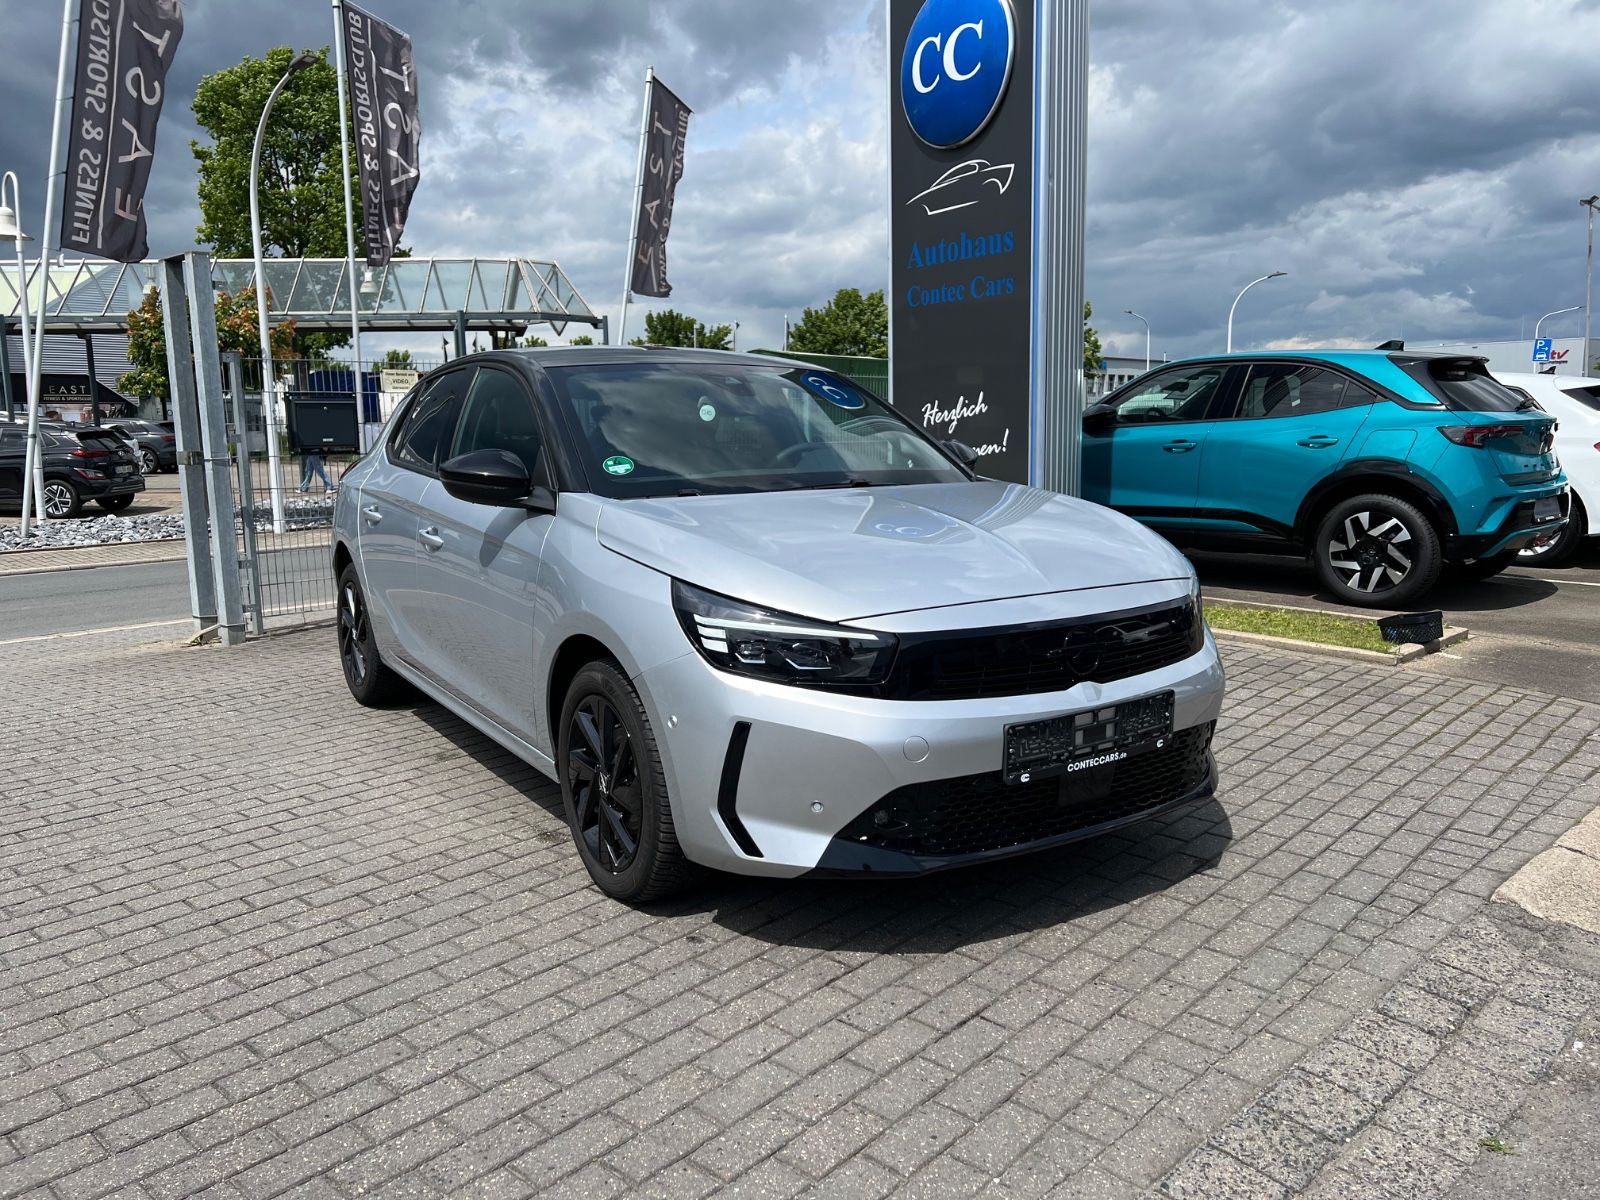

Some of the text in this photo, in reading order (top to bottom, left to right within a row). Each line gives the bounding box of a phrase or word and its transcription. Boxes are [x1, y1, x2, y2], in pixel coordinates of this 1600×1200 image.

[911, 19, 984, 94] CC
[906, 231, 1015, 269] Autohaus
[906, 275, 1015, 308] Contec Cars
[1537, 340, 1545, 349] P
[49, 385, 86, 394] EAST
[921, 390, 988, 434] Herzlich
[1067, 751, 1127, 772] CONTECCARS.de
